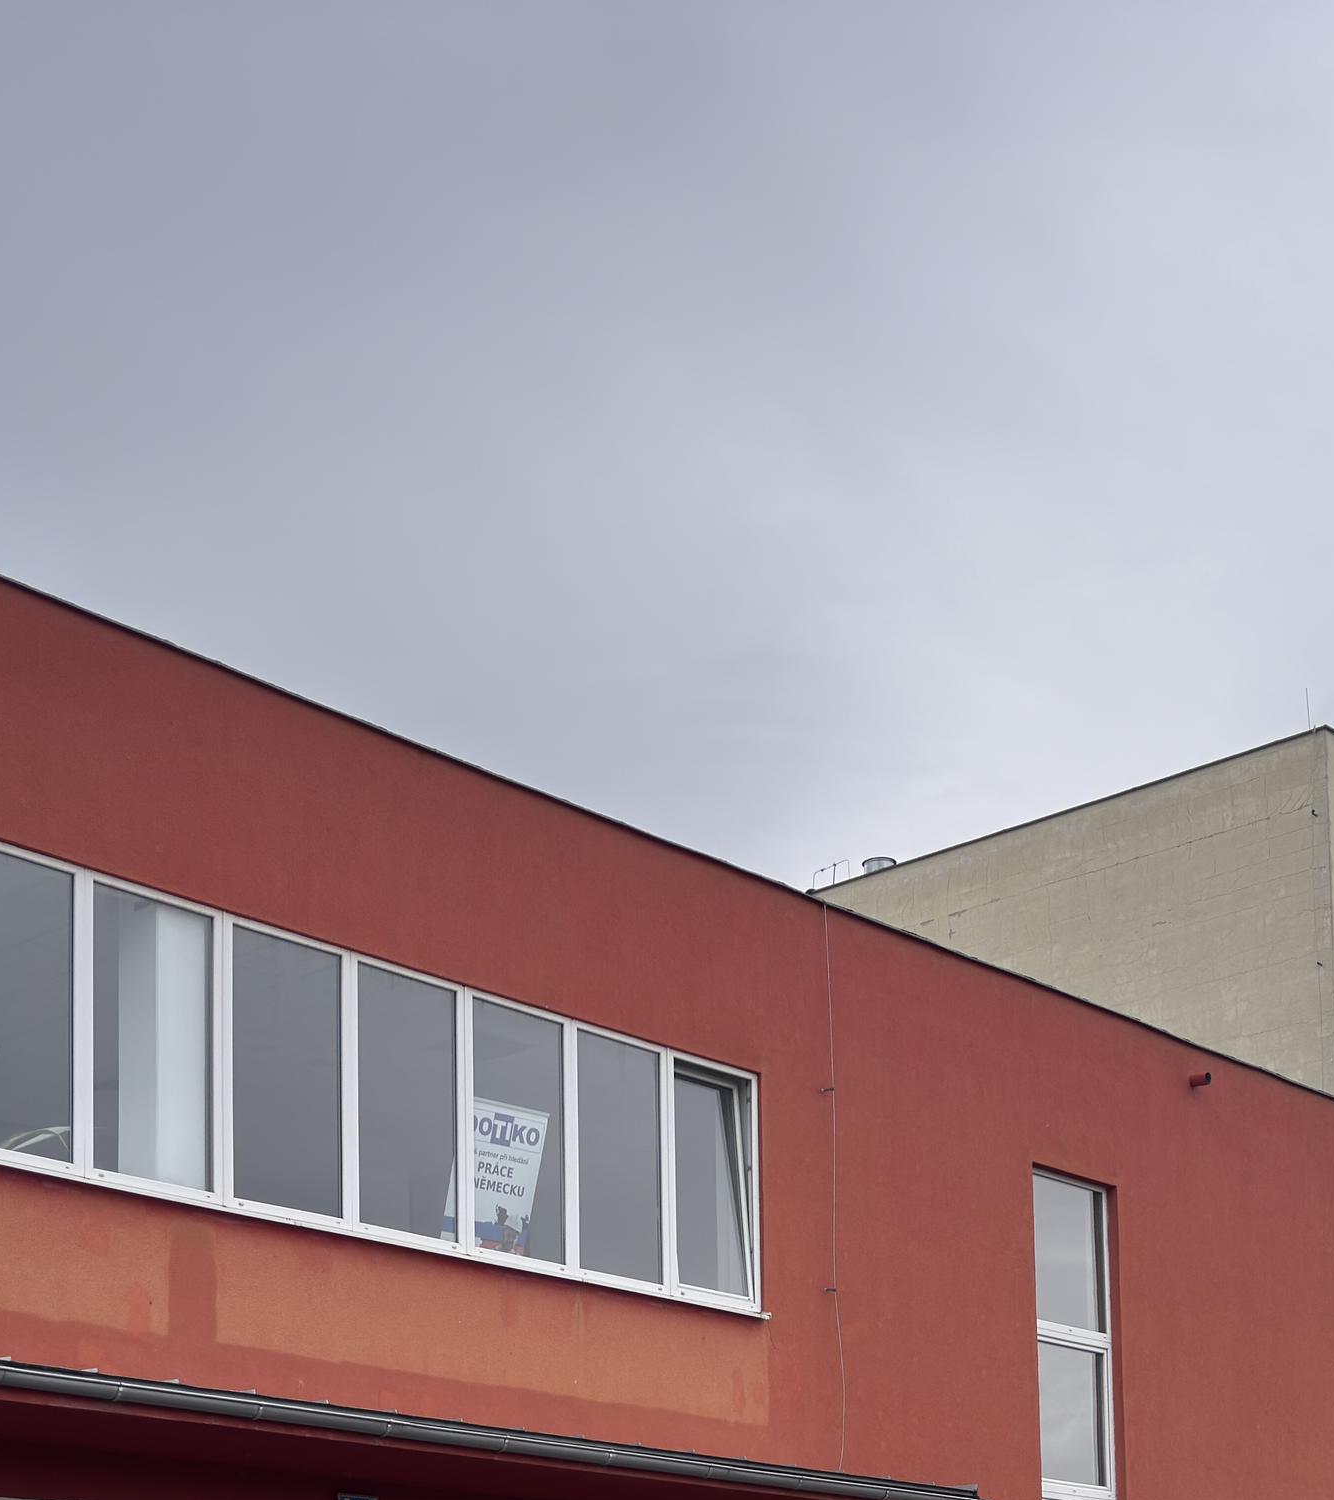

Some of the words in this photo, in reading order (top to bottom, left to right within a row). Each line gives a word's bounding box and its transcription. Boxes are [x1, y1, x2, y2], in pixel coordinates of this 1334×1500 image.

[479, 1150, 498, 1158] partner
[477, 1161, 514, 1178] PRÁCE
[474, 1176, 525, 1197] NĚMECKU
